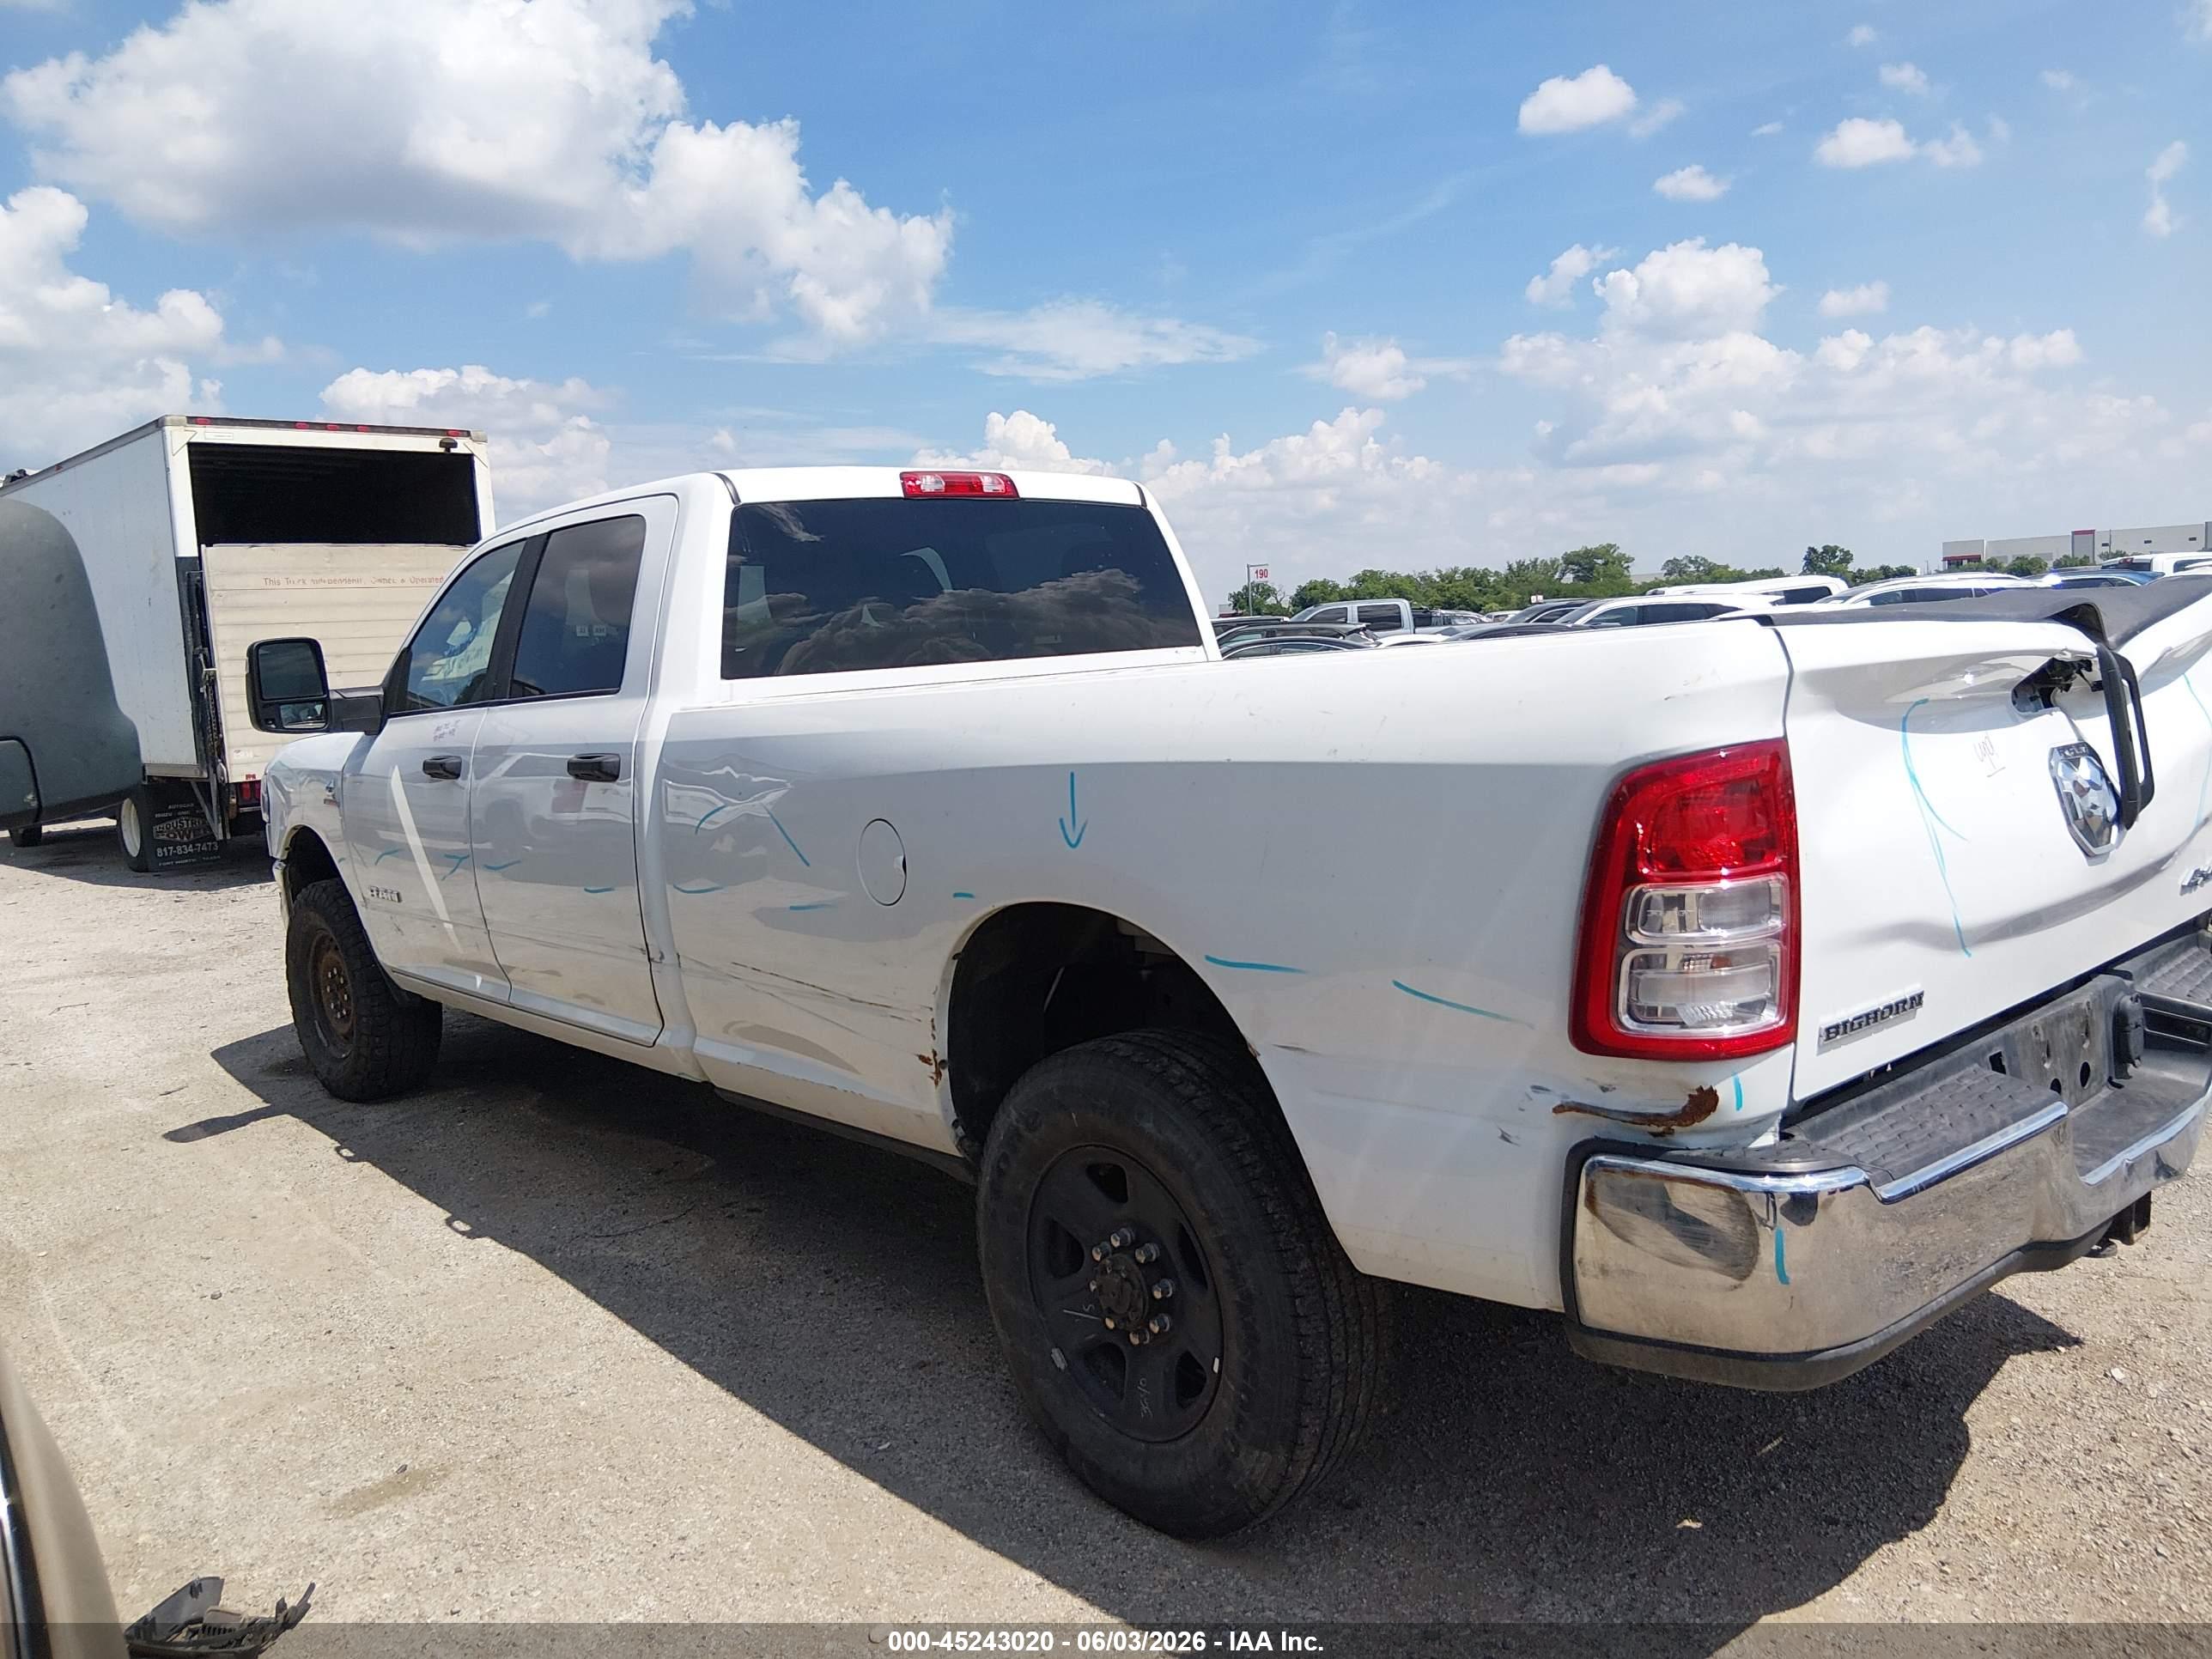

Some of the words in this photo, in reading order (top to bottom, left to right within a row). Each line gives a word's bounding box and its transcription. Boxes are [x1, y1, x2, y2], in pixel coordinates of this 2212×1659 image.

[1255, 568, 1268, 579] 190
[263, 577, 281, 586] This
[156, 842, 219, 857] 817-834-7473
[1822, 989, 1924, 1042] BIGHORN
